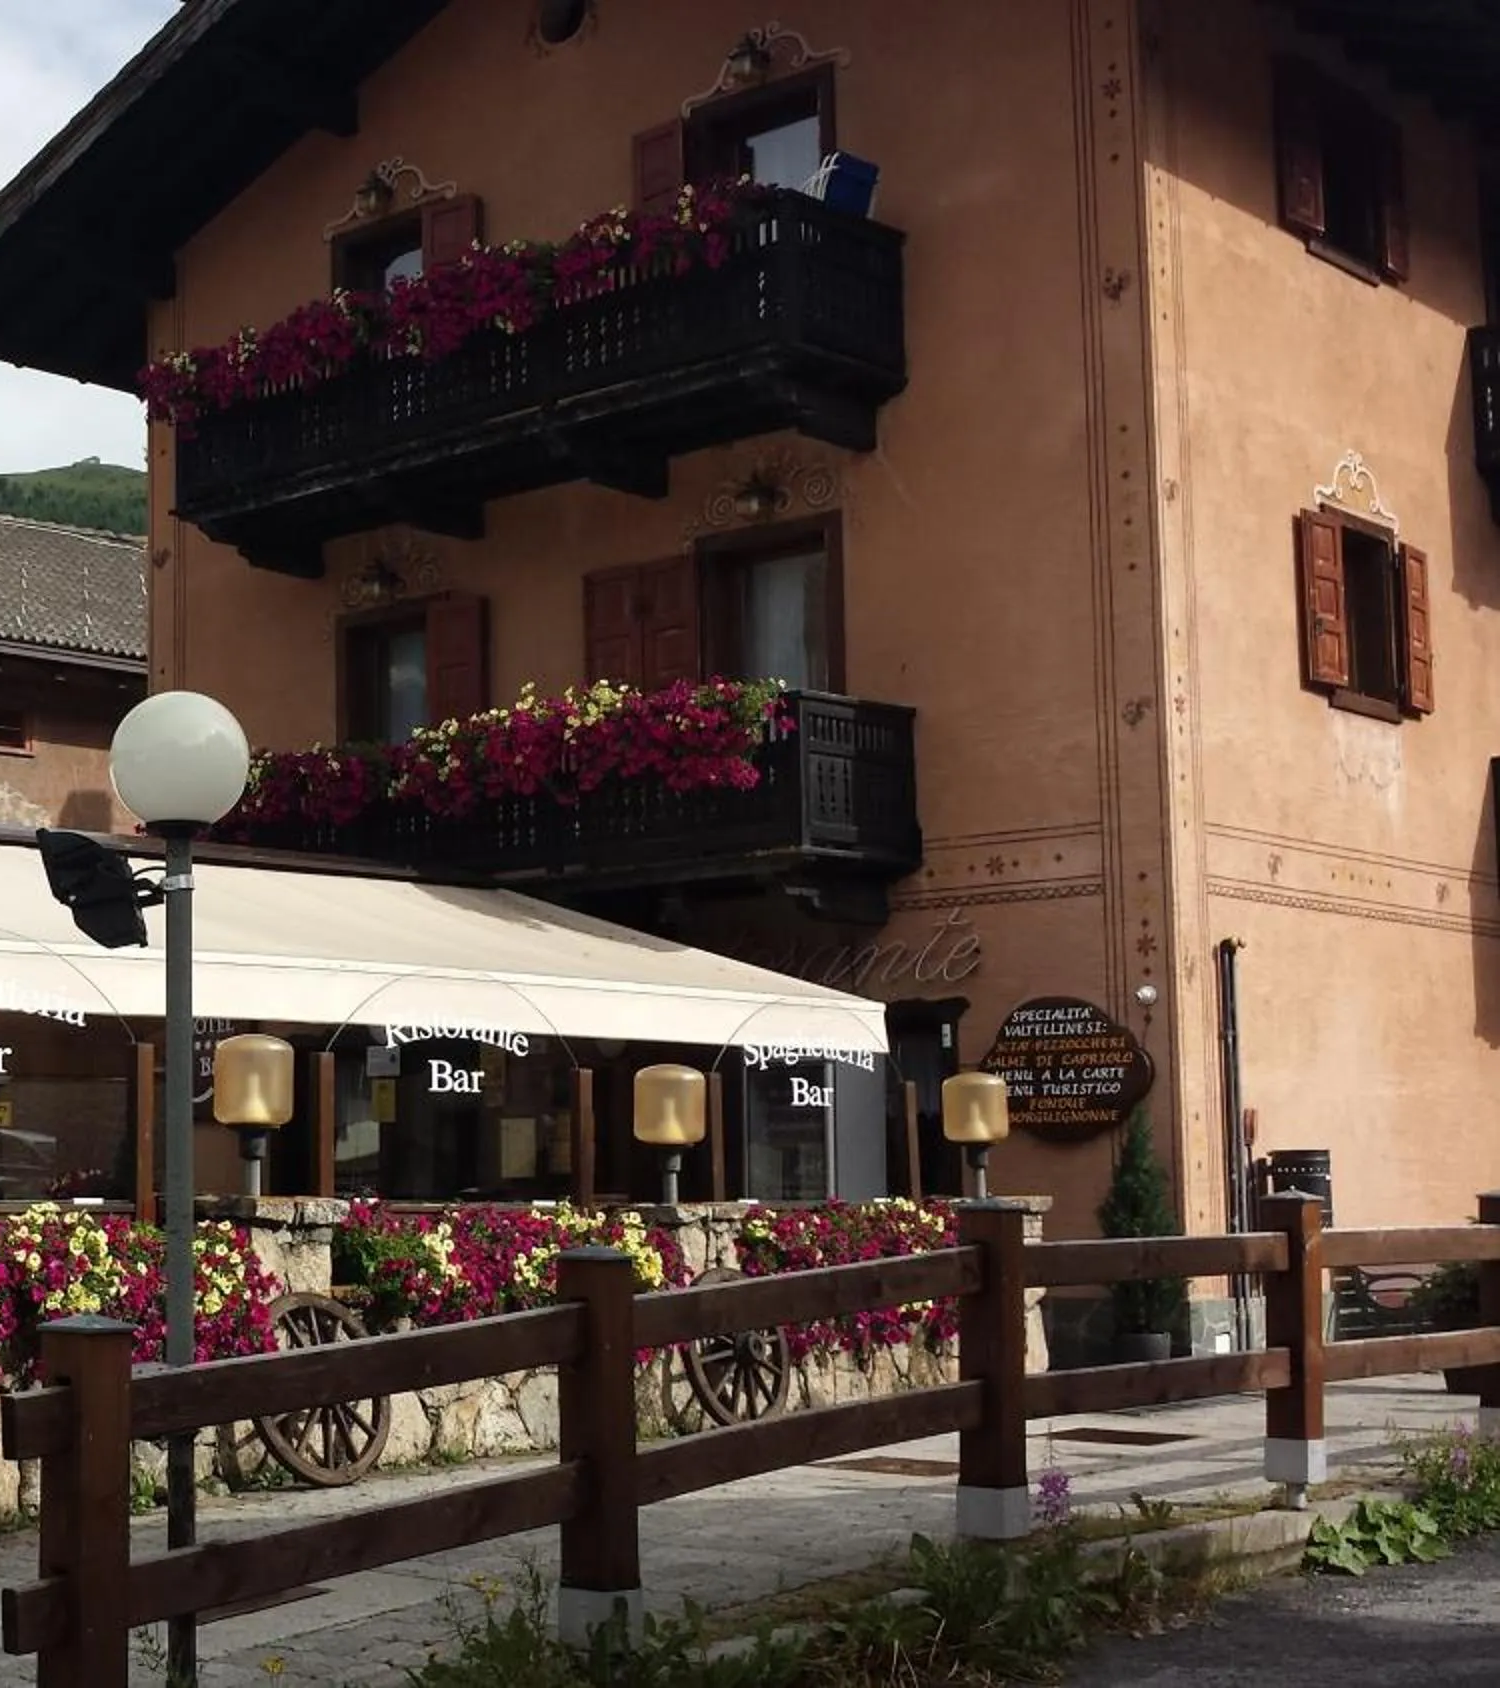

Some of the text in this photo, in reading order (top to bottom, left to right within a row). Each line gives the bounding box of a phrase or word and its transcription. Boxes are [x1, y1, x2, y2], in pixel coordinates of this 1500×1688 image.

[427, 1059, 485, 1093] Bar
[1041, 1070, 1051, 1081] A
[1059, 1069, 1076, 1081] LA
[1082, 1067, 1125, 1079] CARTE
[789, 1077, 834, 1107] Bar
[1006, 1081, 1121, 1097] ENU TURISTICO
